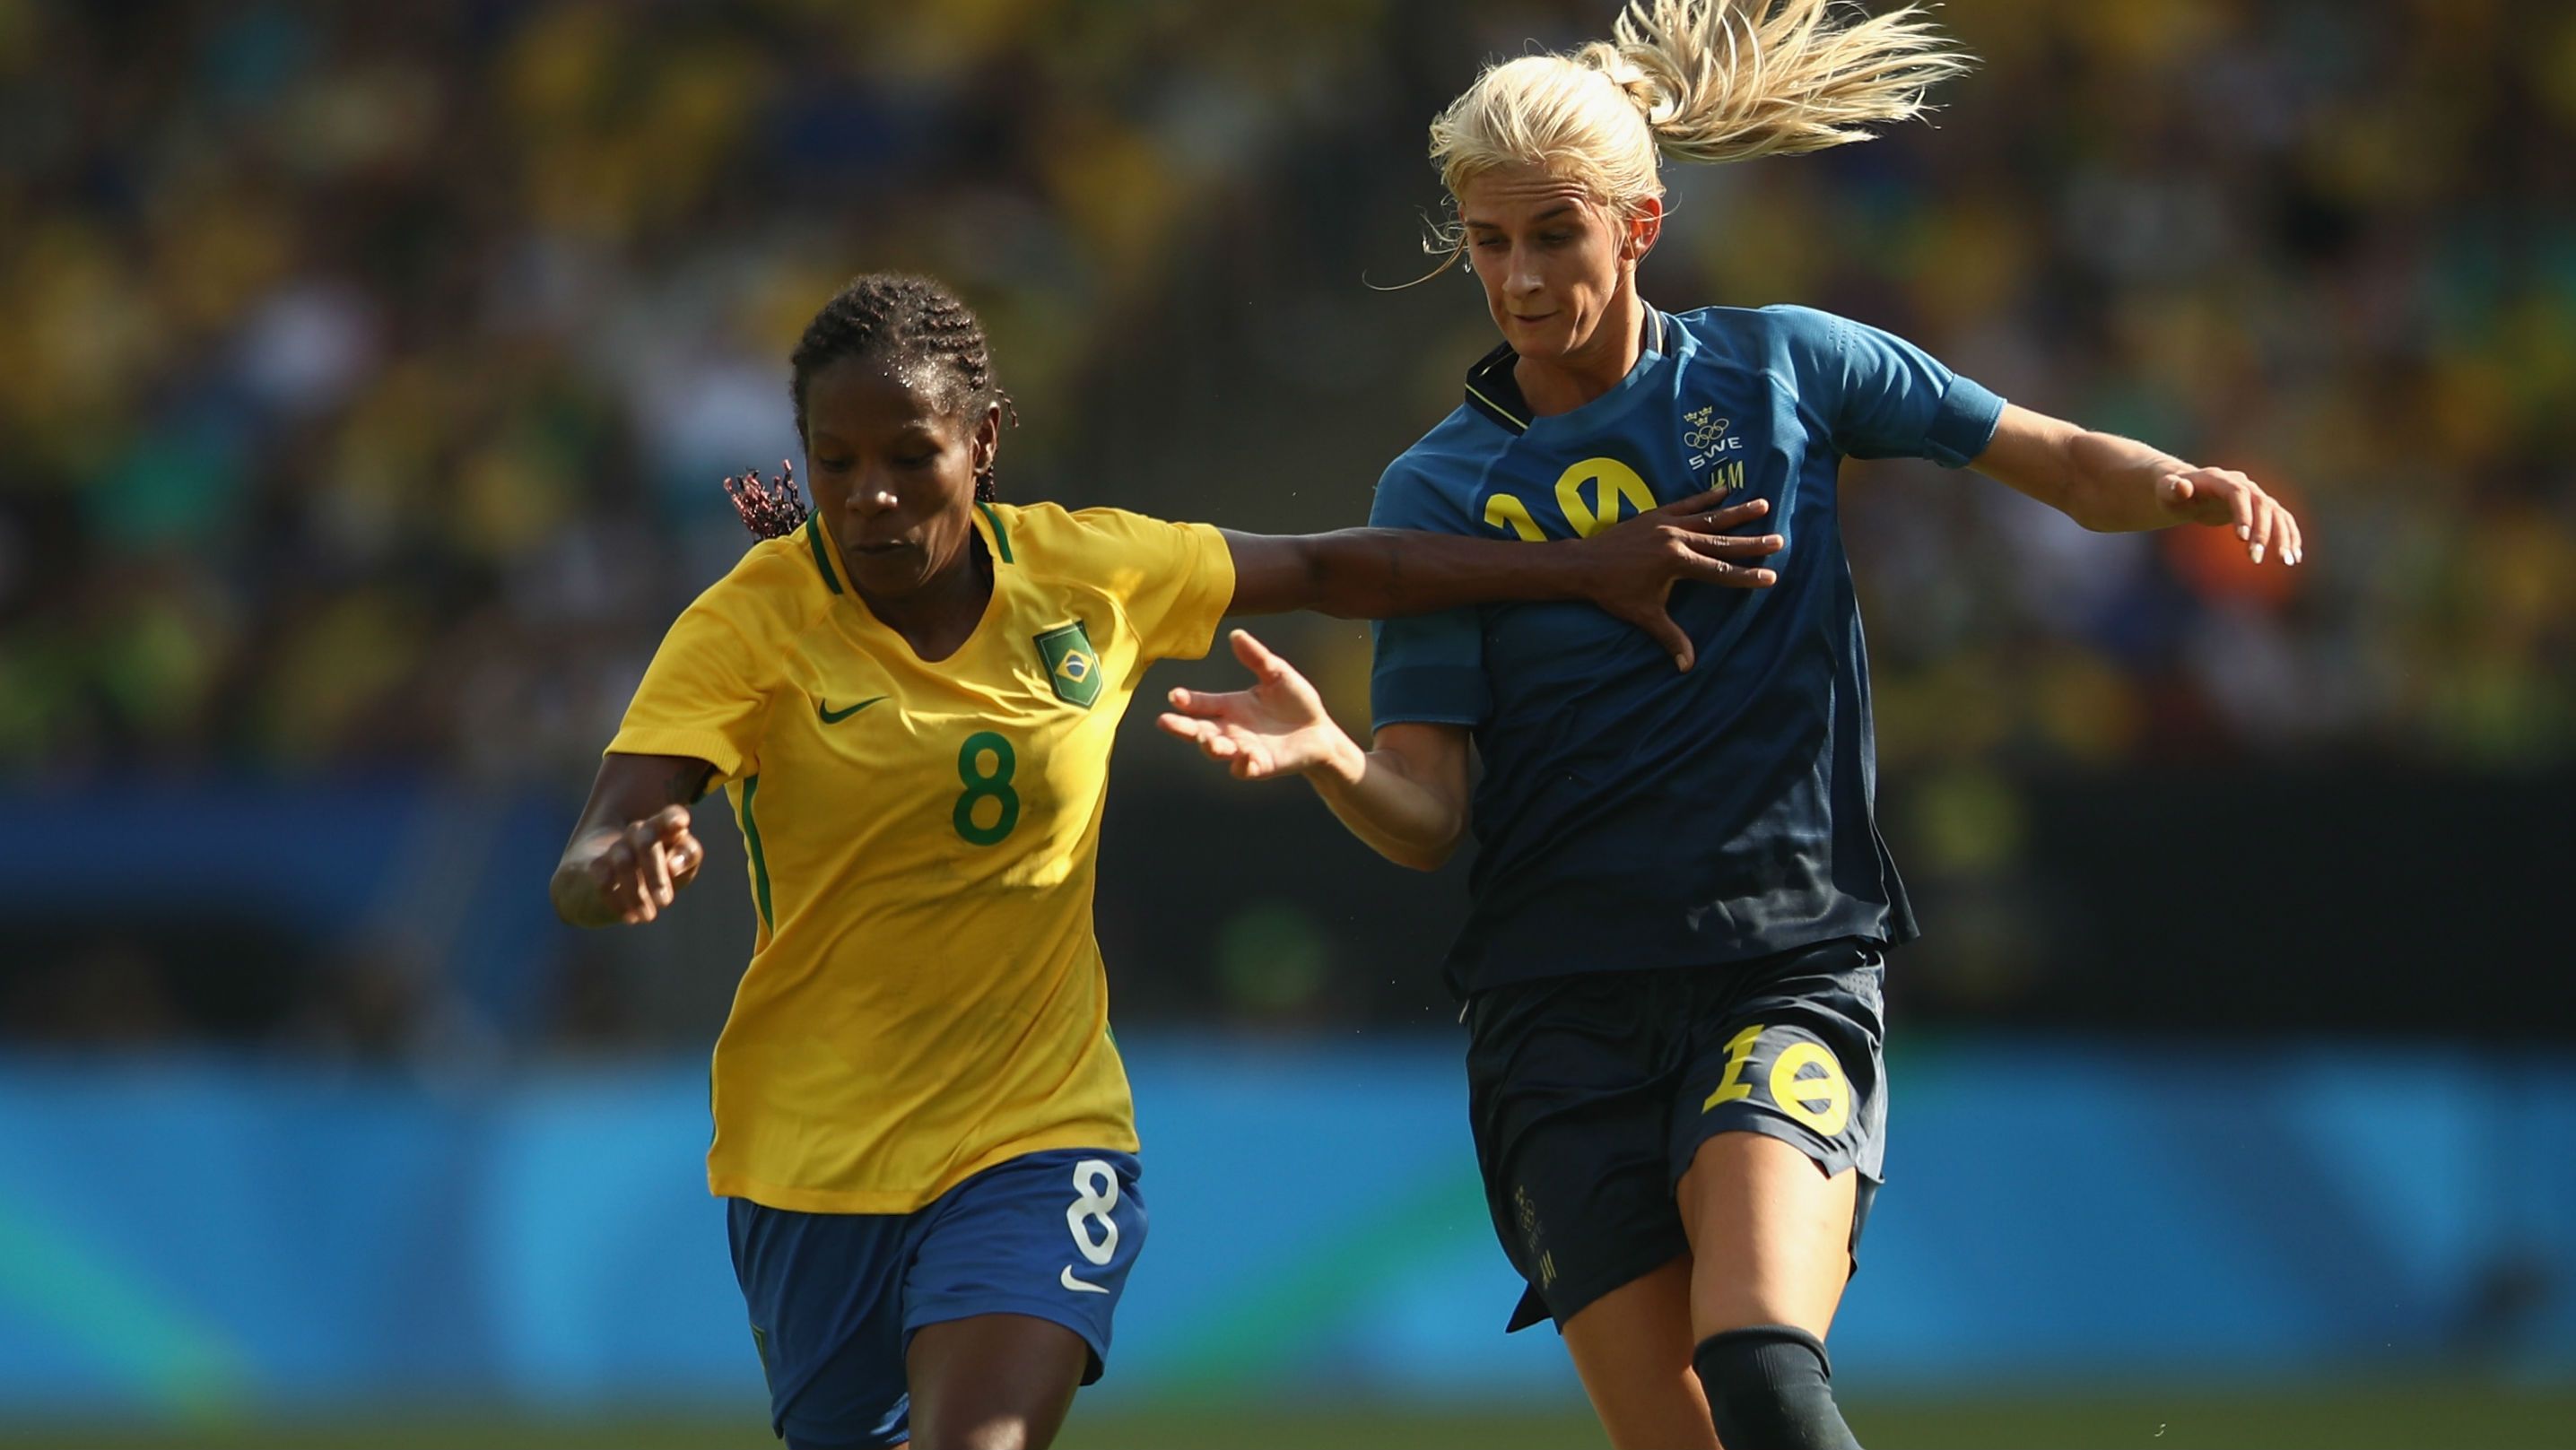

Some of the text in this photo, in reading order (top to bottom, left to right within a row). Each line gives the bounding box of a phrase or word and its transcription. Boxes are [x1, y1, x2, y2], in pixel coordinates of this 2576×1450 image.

[1688, 436, 1743, 471] SWE
[953, 731, 1020, 846] 8
[1701, 1023, 1850, 1137] 10
[1066, 1159, 1118, 1266] 8
